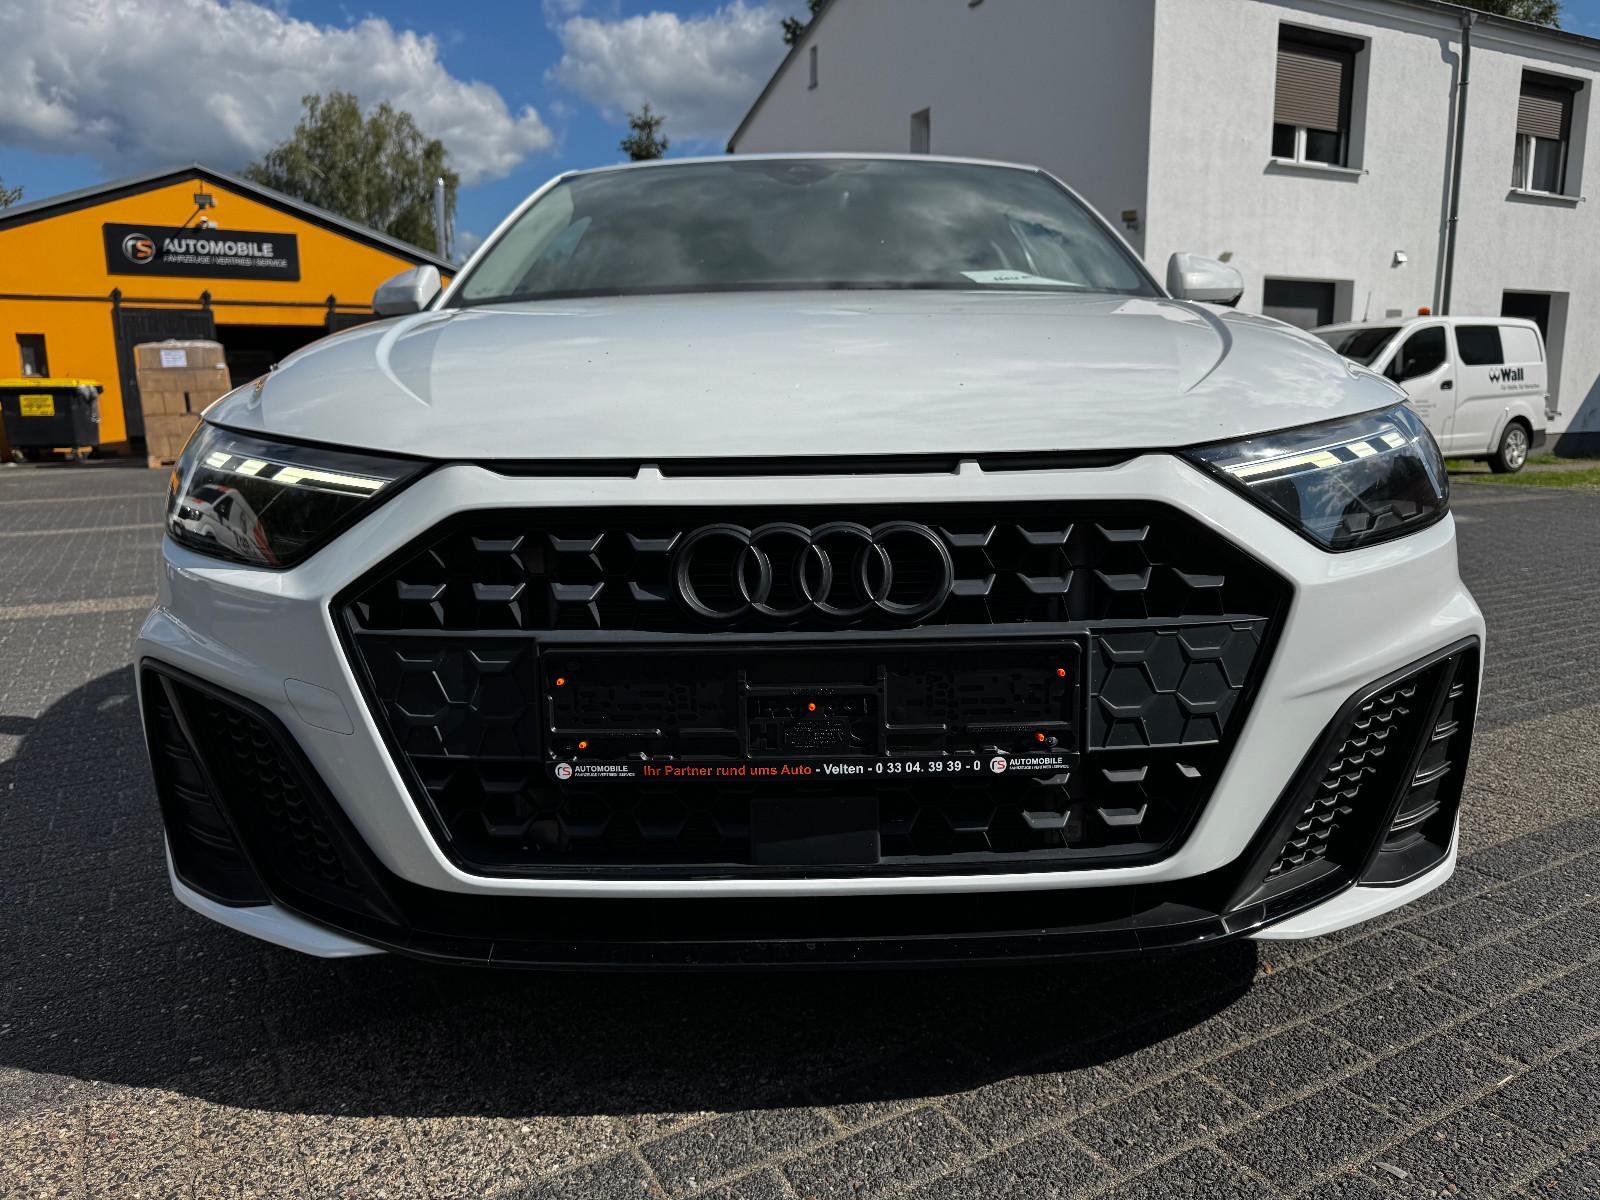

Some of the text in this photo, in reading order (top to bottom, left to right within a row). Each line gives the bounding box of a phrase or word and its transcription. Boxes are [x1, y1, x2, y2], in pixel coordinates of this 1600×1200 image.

[163, 238, 274, 257] AUTOMOBILE
[1500, 368, 1523, 381] Wall
[643, 765, 661, 776] Ihr
[664, 765, 712, 776] Partner
[716, 765, 746, 776] rund
[750, 766, 777, 775] ums
[780, 764, 812, 775] Auto
[824, 763, 864, 774] Velten
[875, 762, 883, 773] 0
[887, 762, 902, 773] 33
[905, 761, 924, 773] 04.
[928, 761, 943, 772] 39
[946, 761, 961, 772] 39
[973, 760, 981, 771] 0
[1009, 757, 1063, 766] AUTOMOBILE
